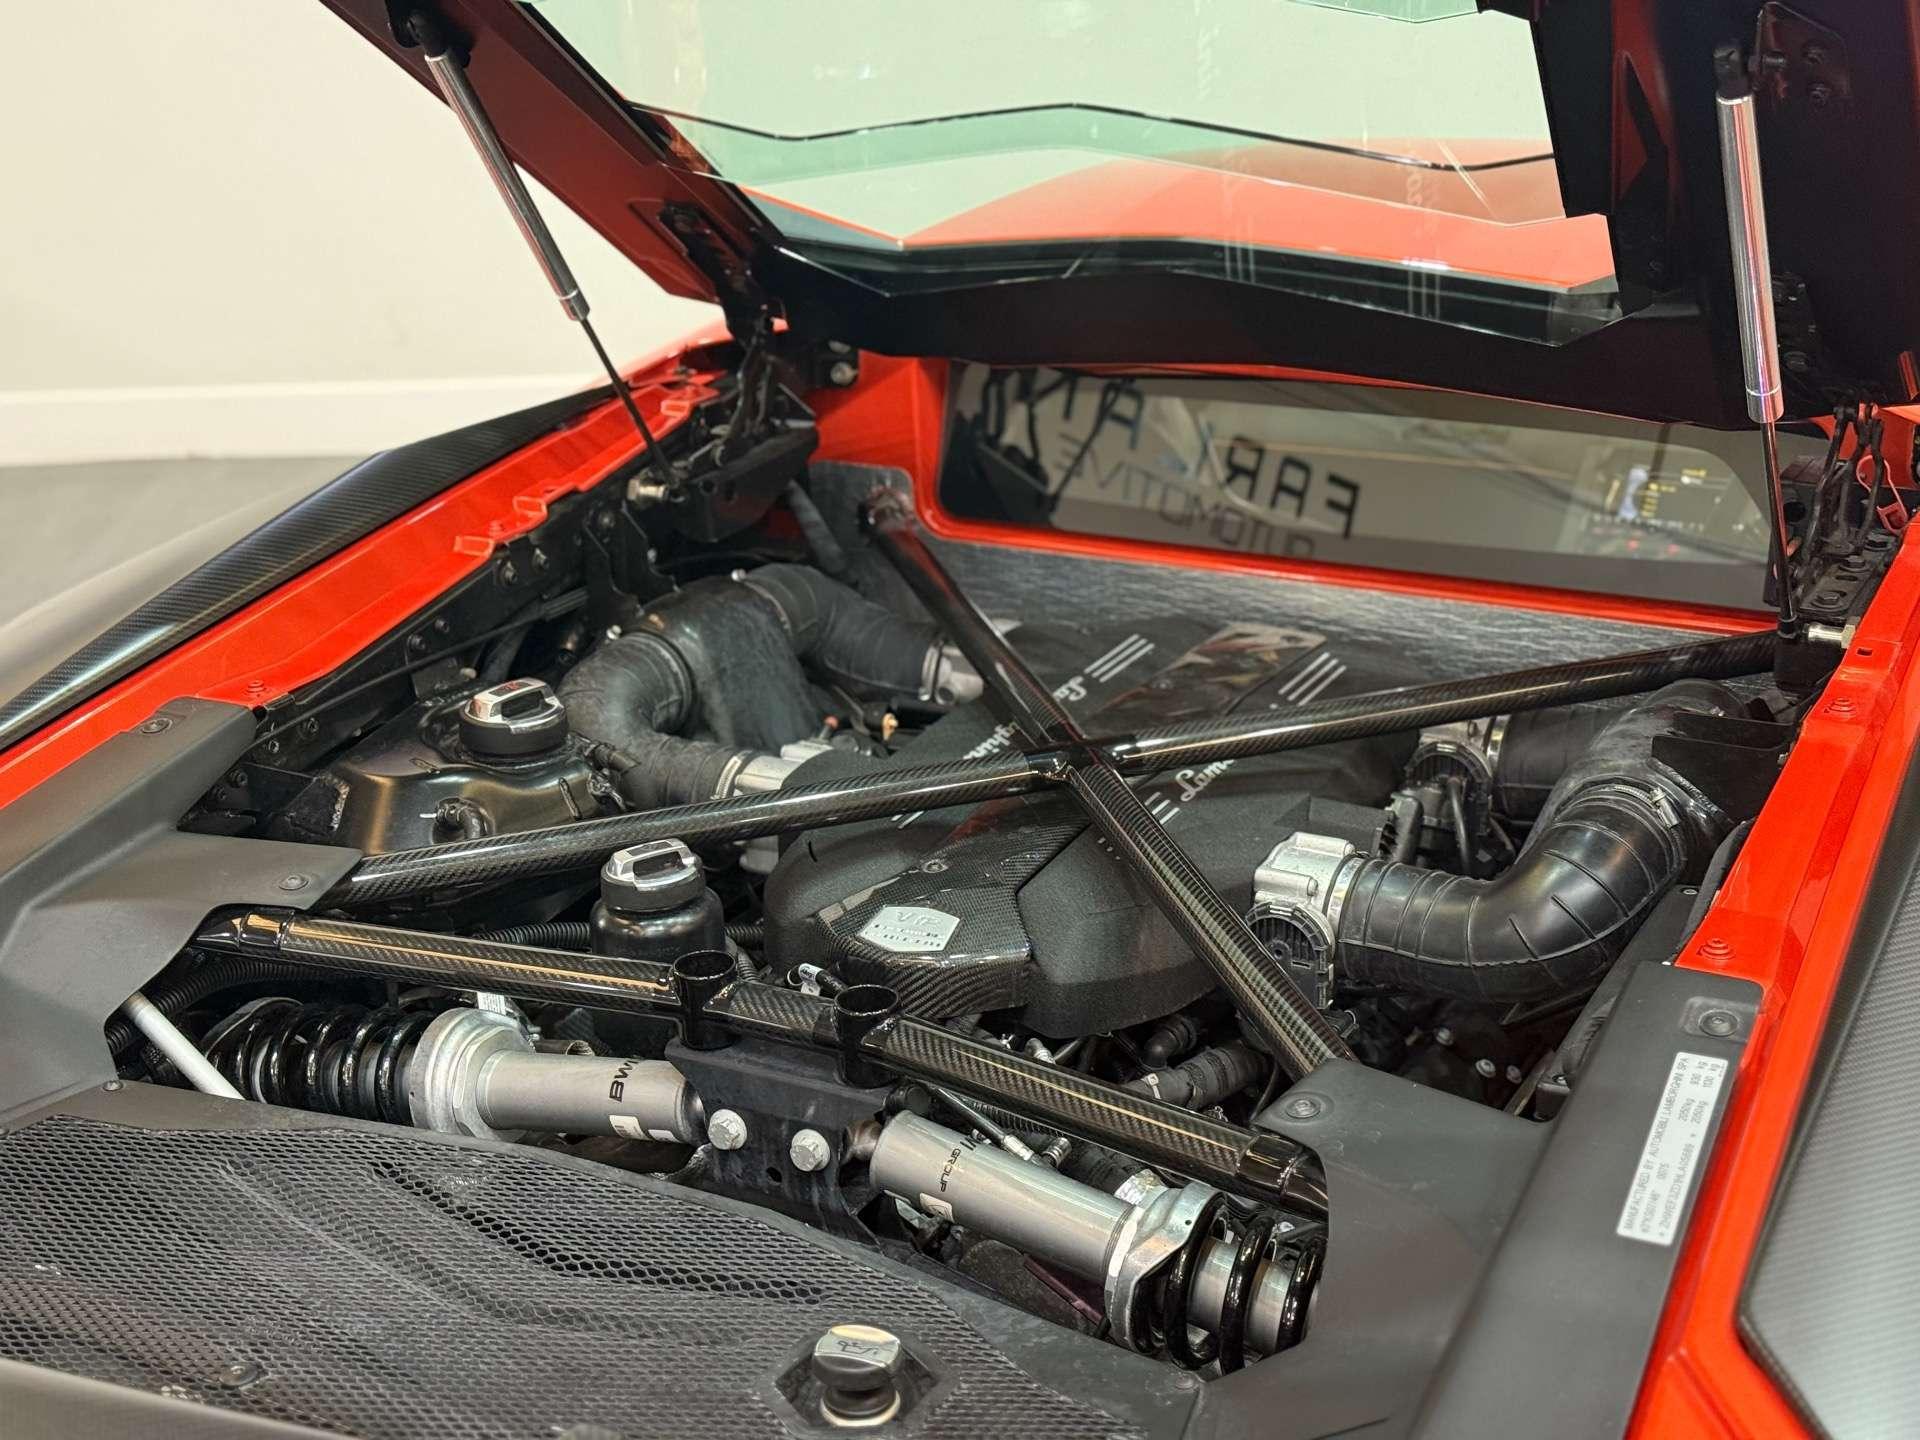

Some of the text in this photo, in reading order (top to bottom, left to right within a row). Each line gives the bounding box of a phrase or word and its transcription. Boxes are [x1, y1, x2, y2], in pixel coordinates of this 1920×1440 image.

[940, 1148, 961, 1192] GROUP
[1624, 1173, 1650, 1229] MANUFACTURED
[1644, 1160, 1655, 1170] BY
[1663, 1073, 1684, 1115] LAMBORGHINI
